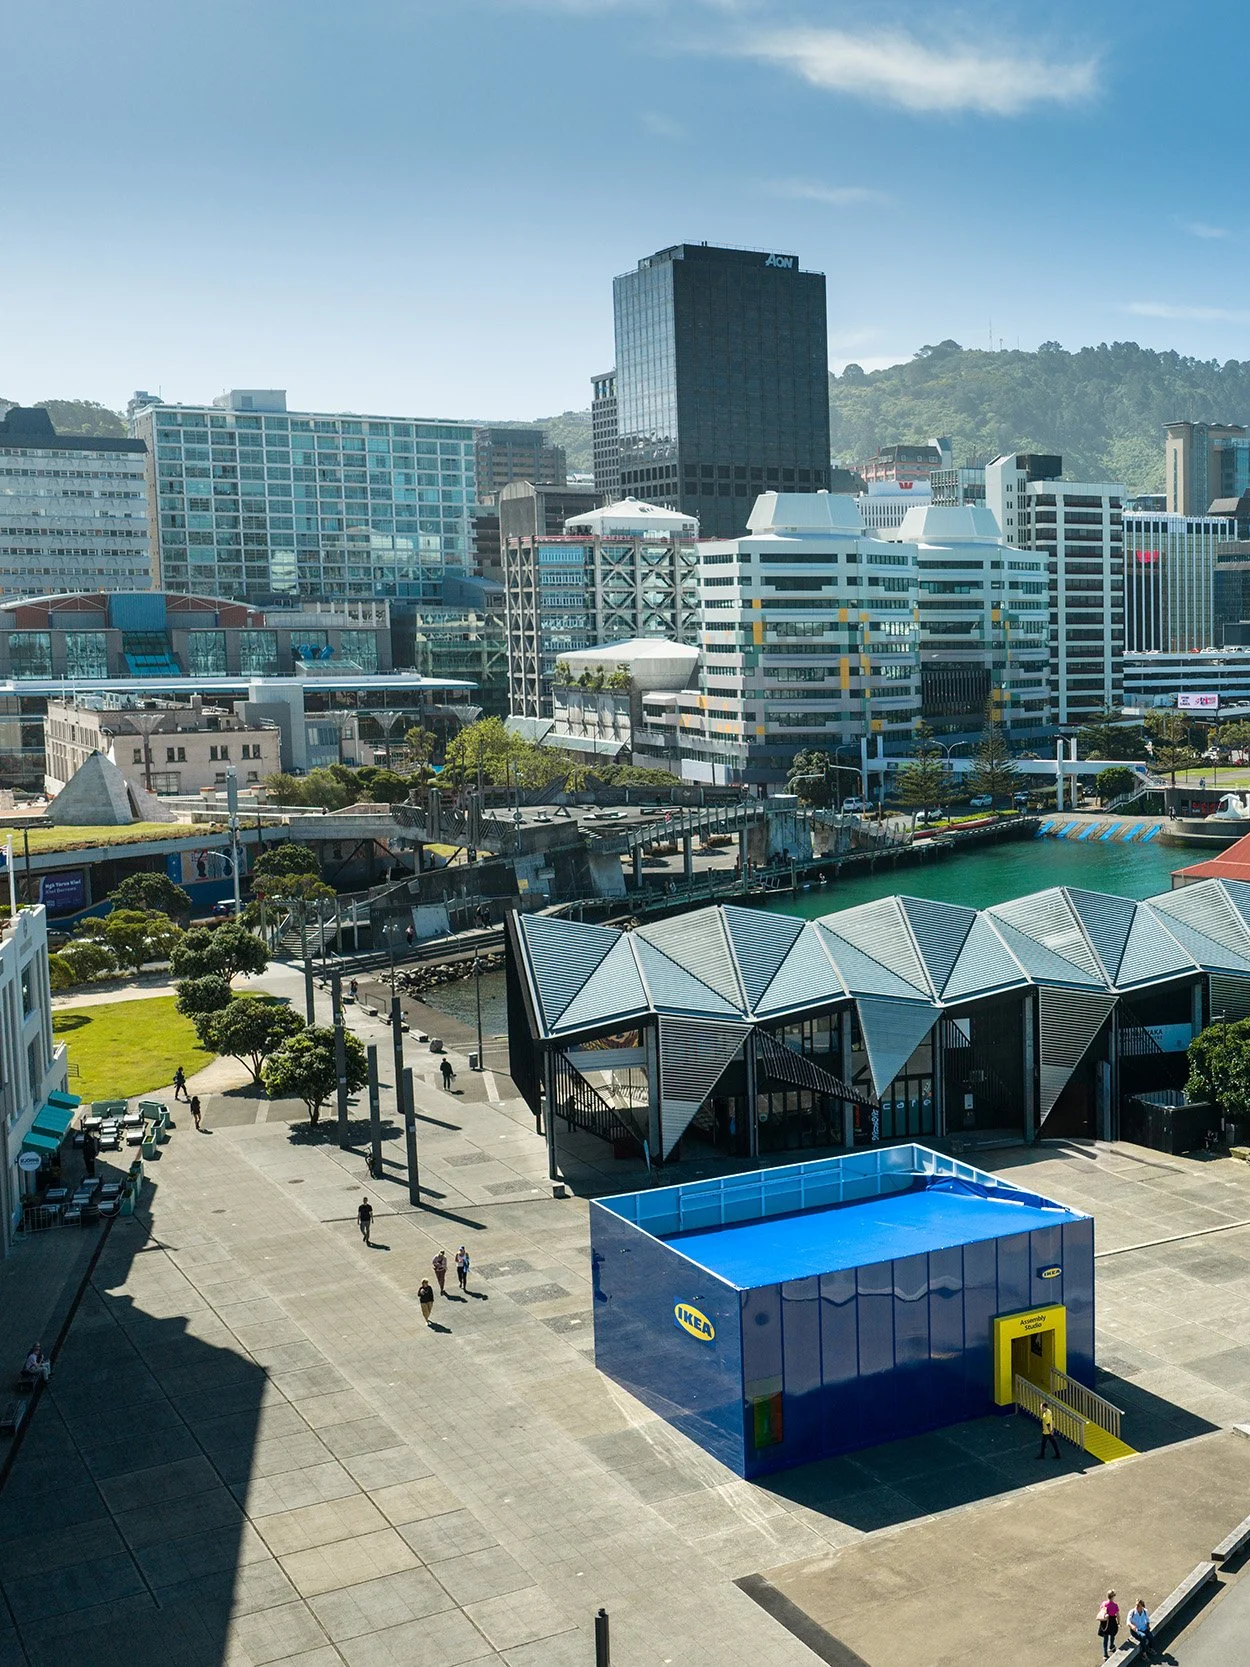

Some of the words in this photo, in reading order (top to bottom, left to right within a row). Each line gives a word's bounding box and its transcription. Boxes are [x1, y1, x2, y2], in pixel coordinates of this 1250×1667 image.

[1043, 1269, 1061, 1277] IKEA
[678, 1306, 712, 1338] IKEA
[1020, 1315, 1046, 1326] Assembly
[1025, 1322, 1042, 1331] Studio
